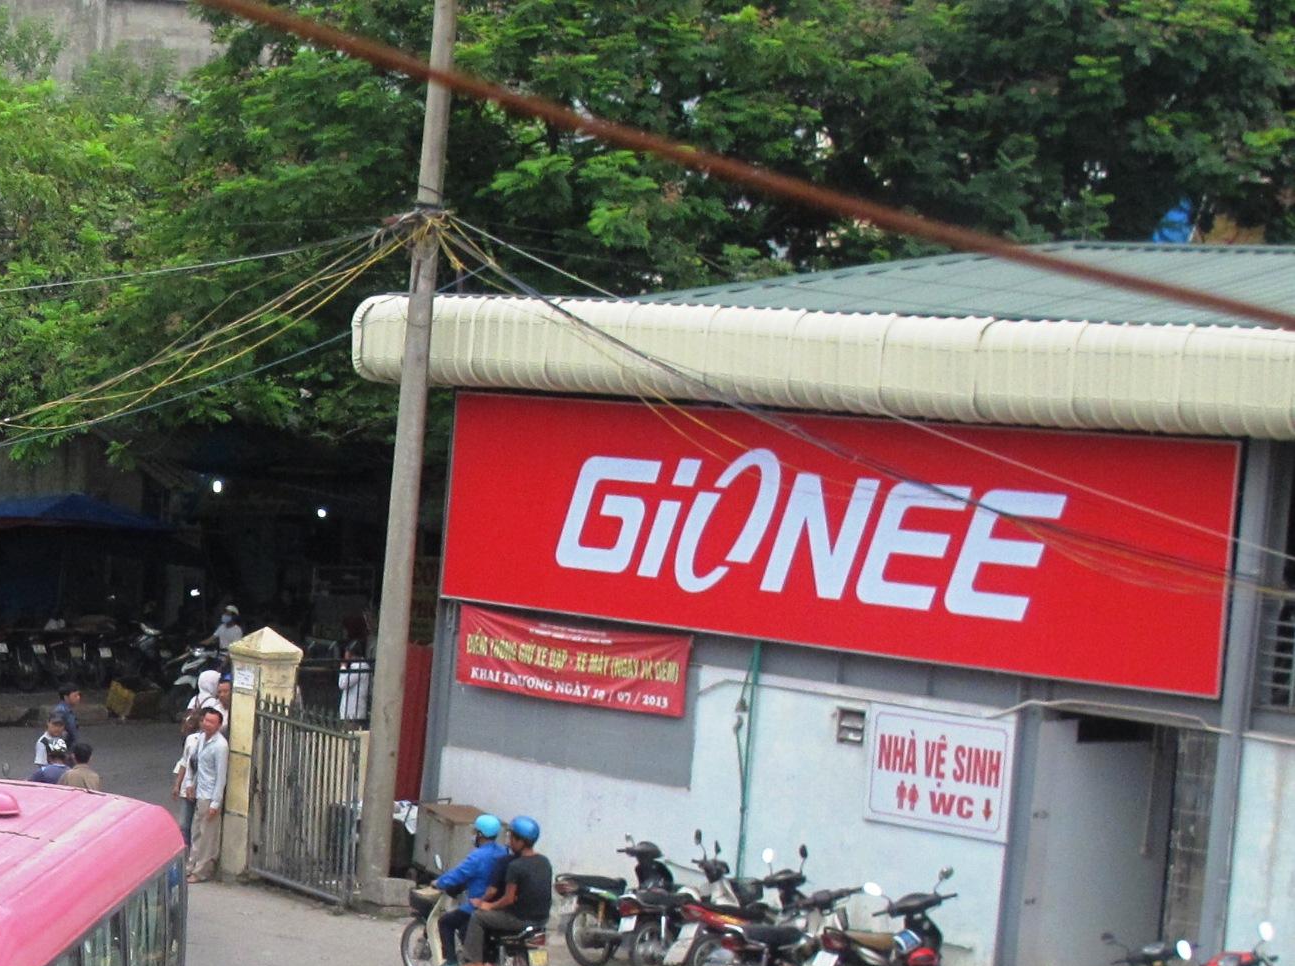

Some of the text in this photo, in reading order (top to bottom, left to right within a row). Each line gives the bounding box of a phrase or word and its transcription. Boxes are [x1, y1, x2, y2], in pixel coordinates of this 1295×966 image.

[470, 667, 500, 683] KHAI
[555, 680, 591, 700] NGÀY
[877, 729, 1002, 788] NHÀ VỆ SINH
[929, 790, 974, 820] WC
